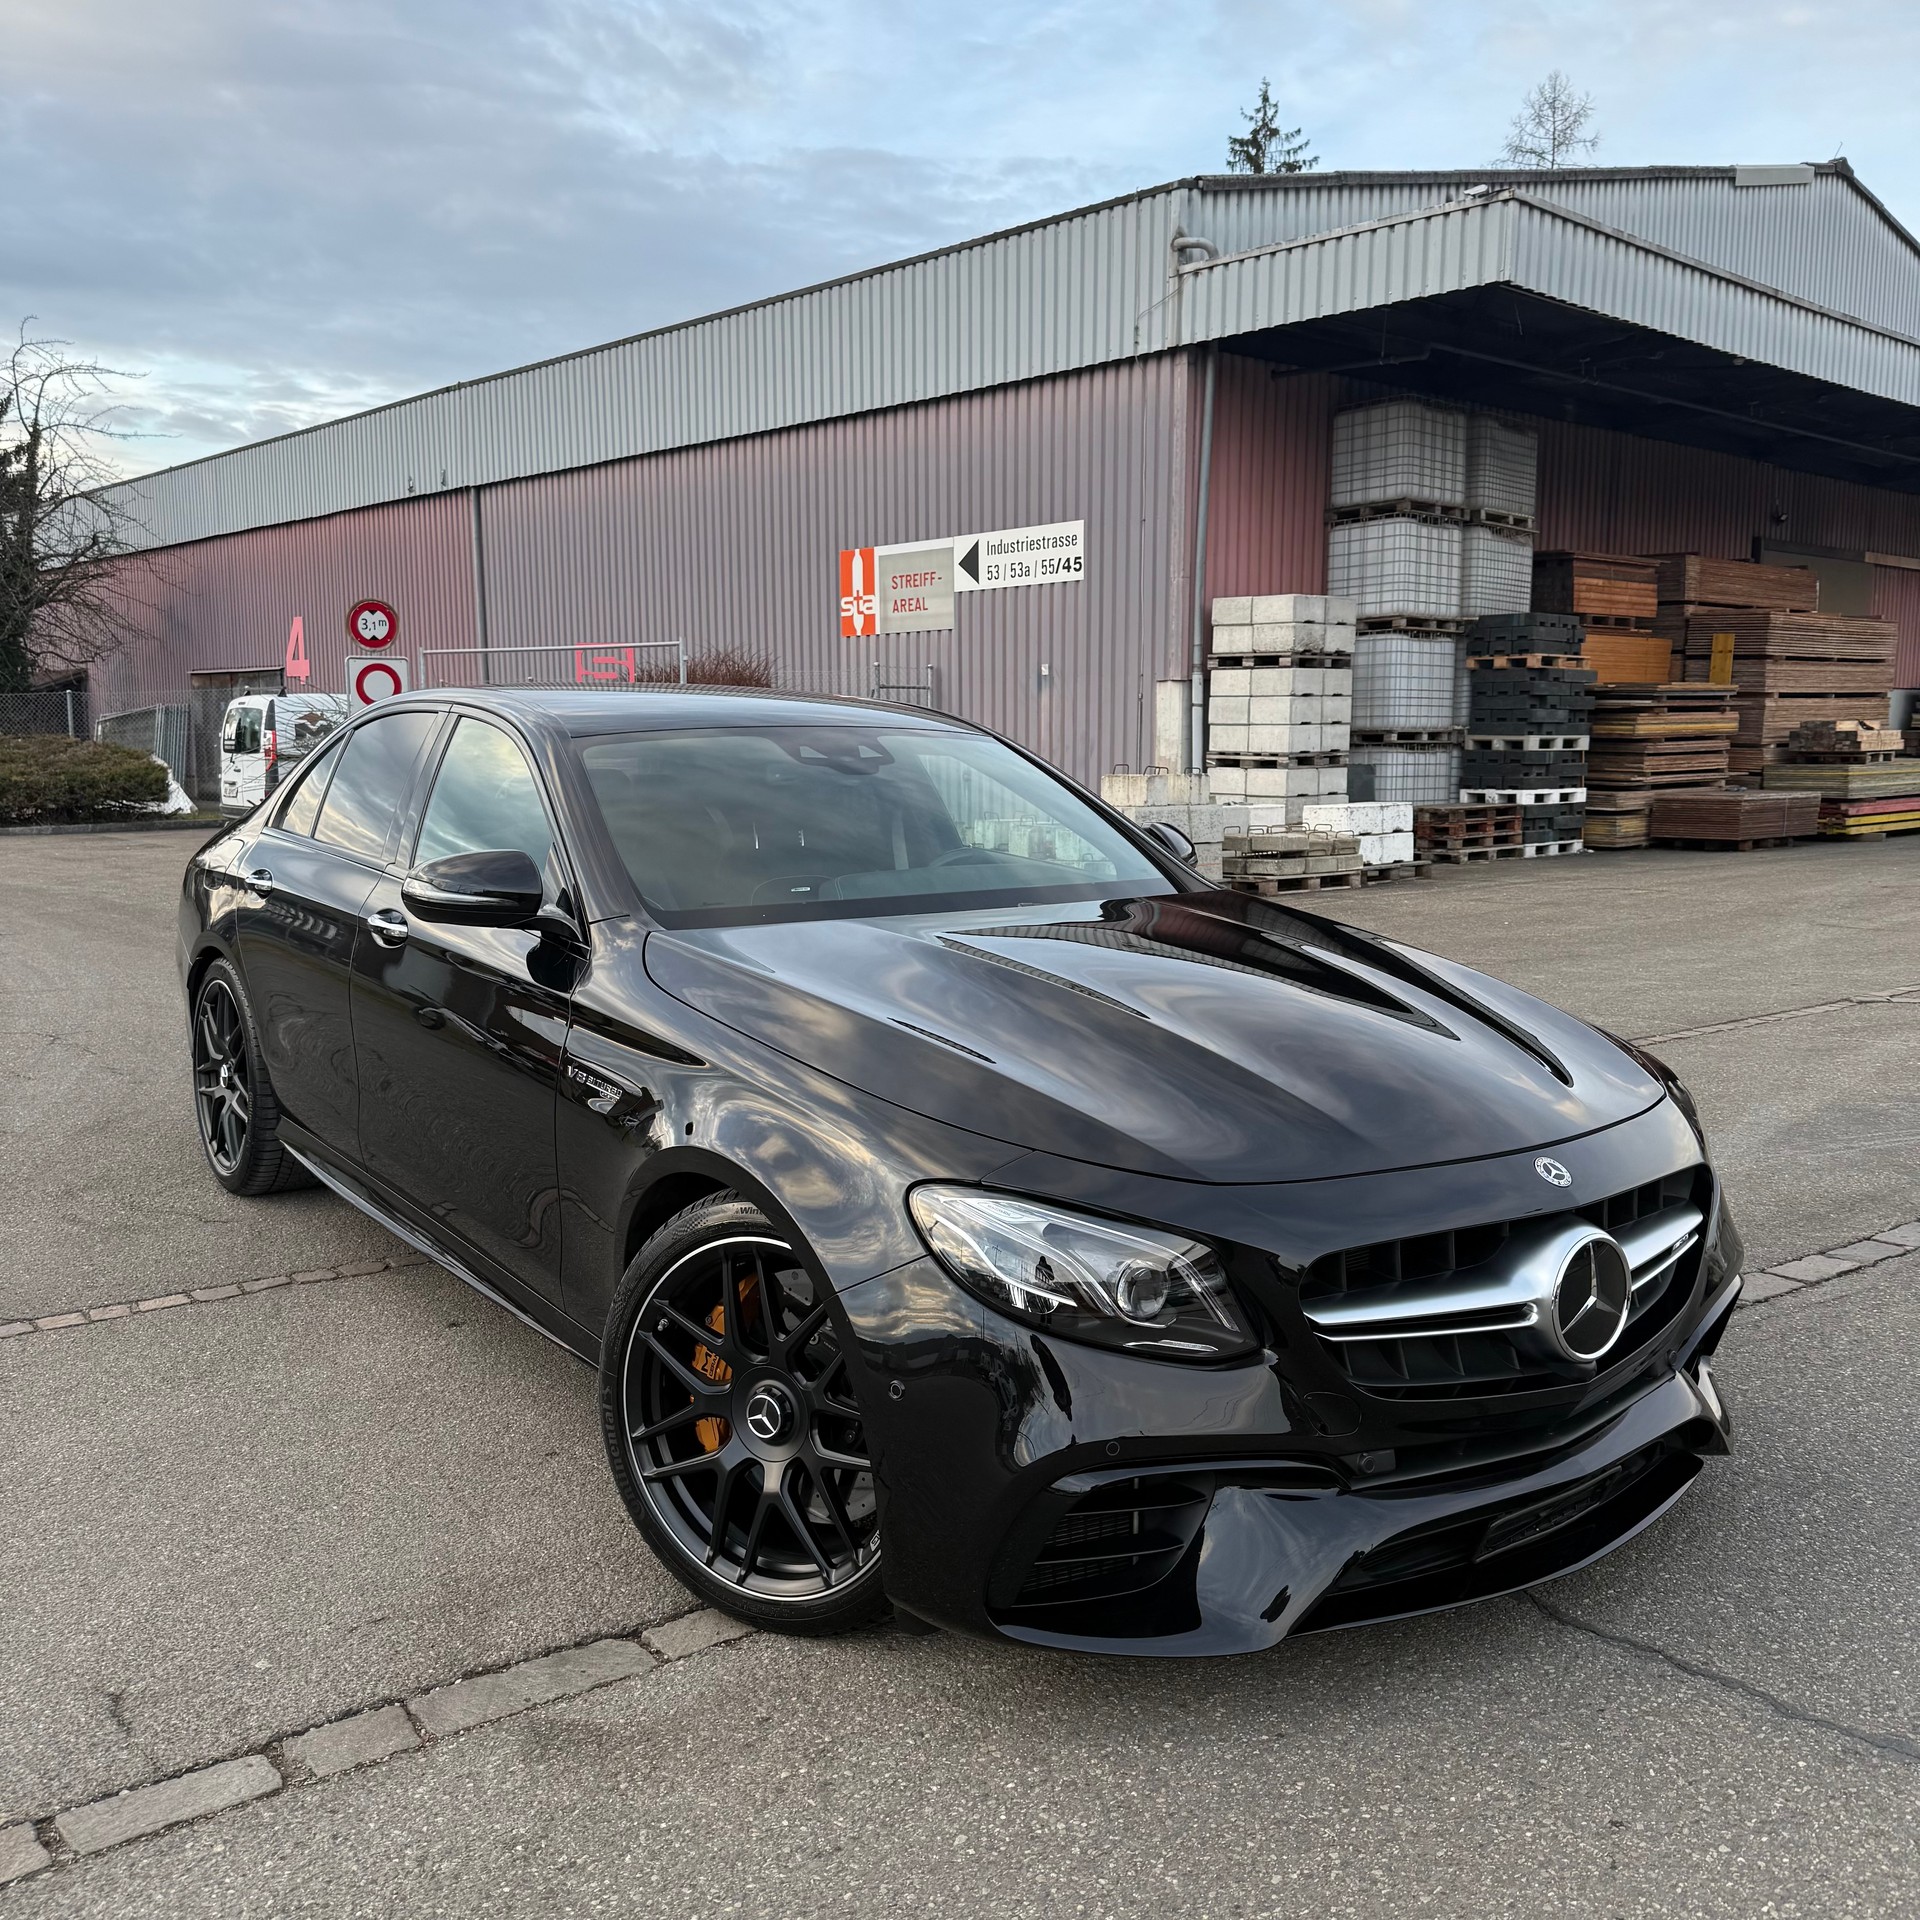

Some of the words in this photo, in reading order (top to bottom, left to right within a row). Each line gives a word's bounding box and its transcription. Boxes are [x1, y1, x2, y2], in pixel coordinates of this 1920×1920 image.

[987, 533, 1078, 556] Industriestrasse
[891, 571, 942, 590] STREIFF-
[987, 565, 1000, 581] 53
[1010, 562, 1030, 579] 53a
[892, 597, 929, 614] AREAL
[286, 616, 310, 685] 4
